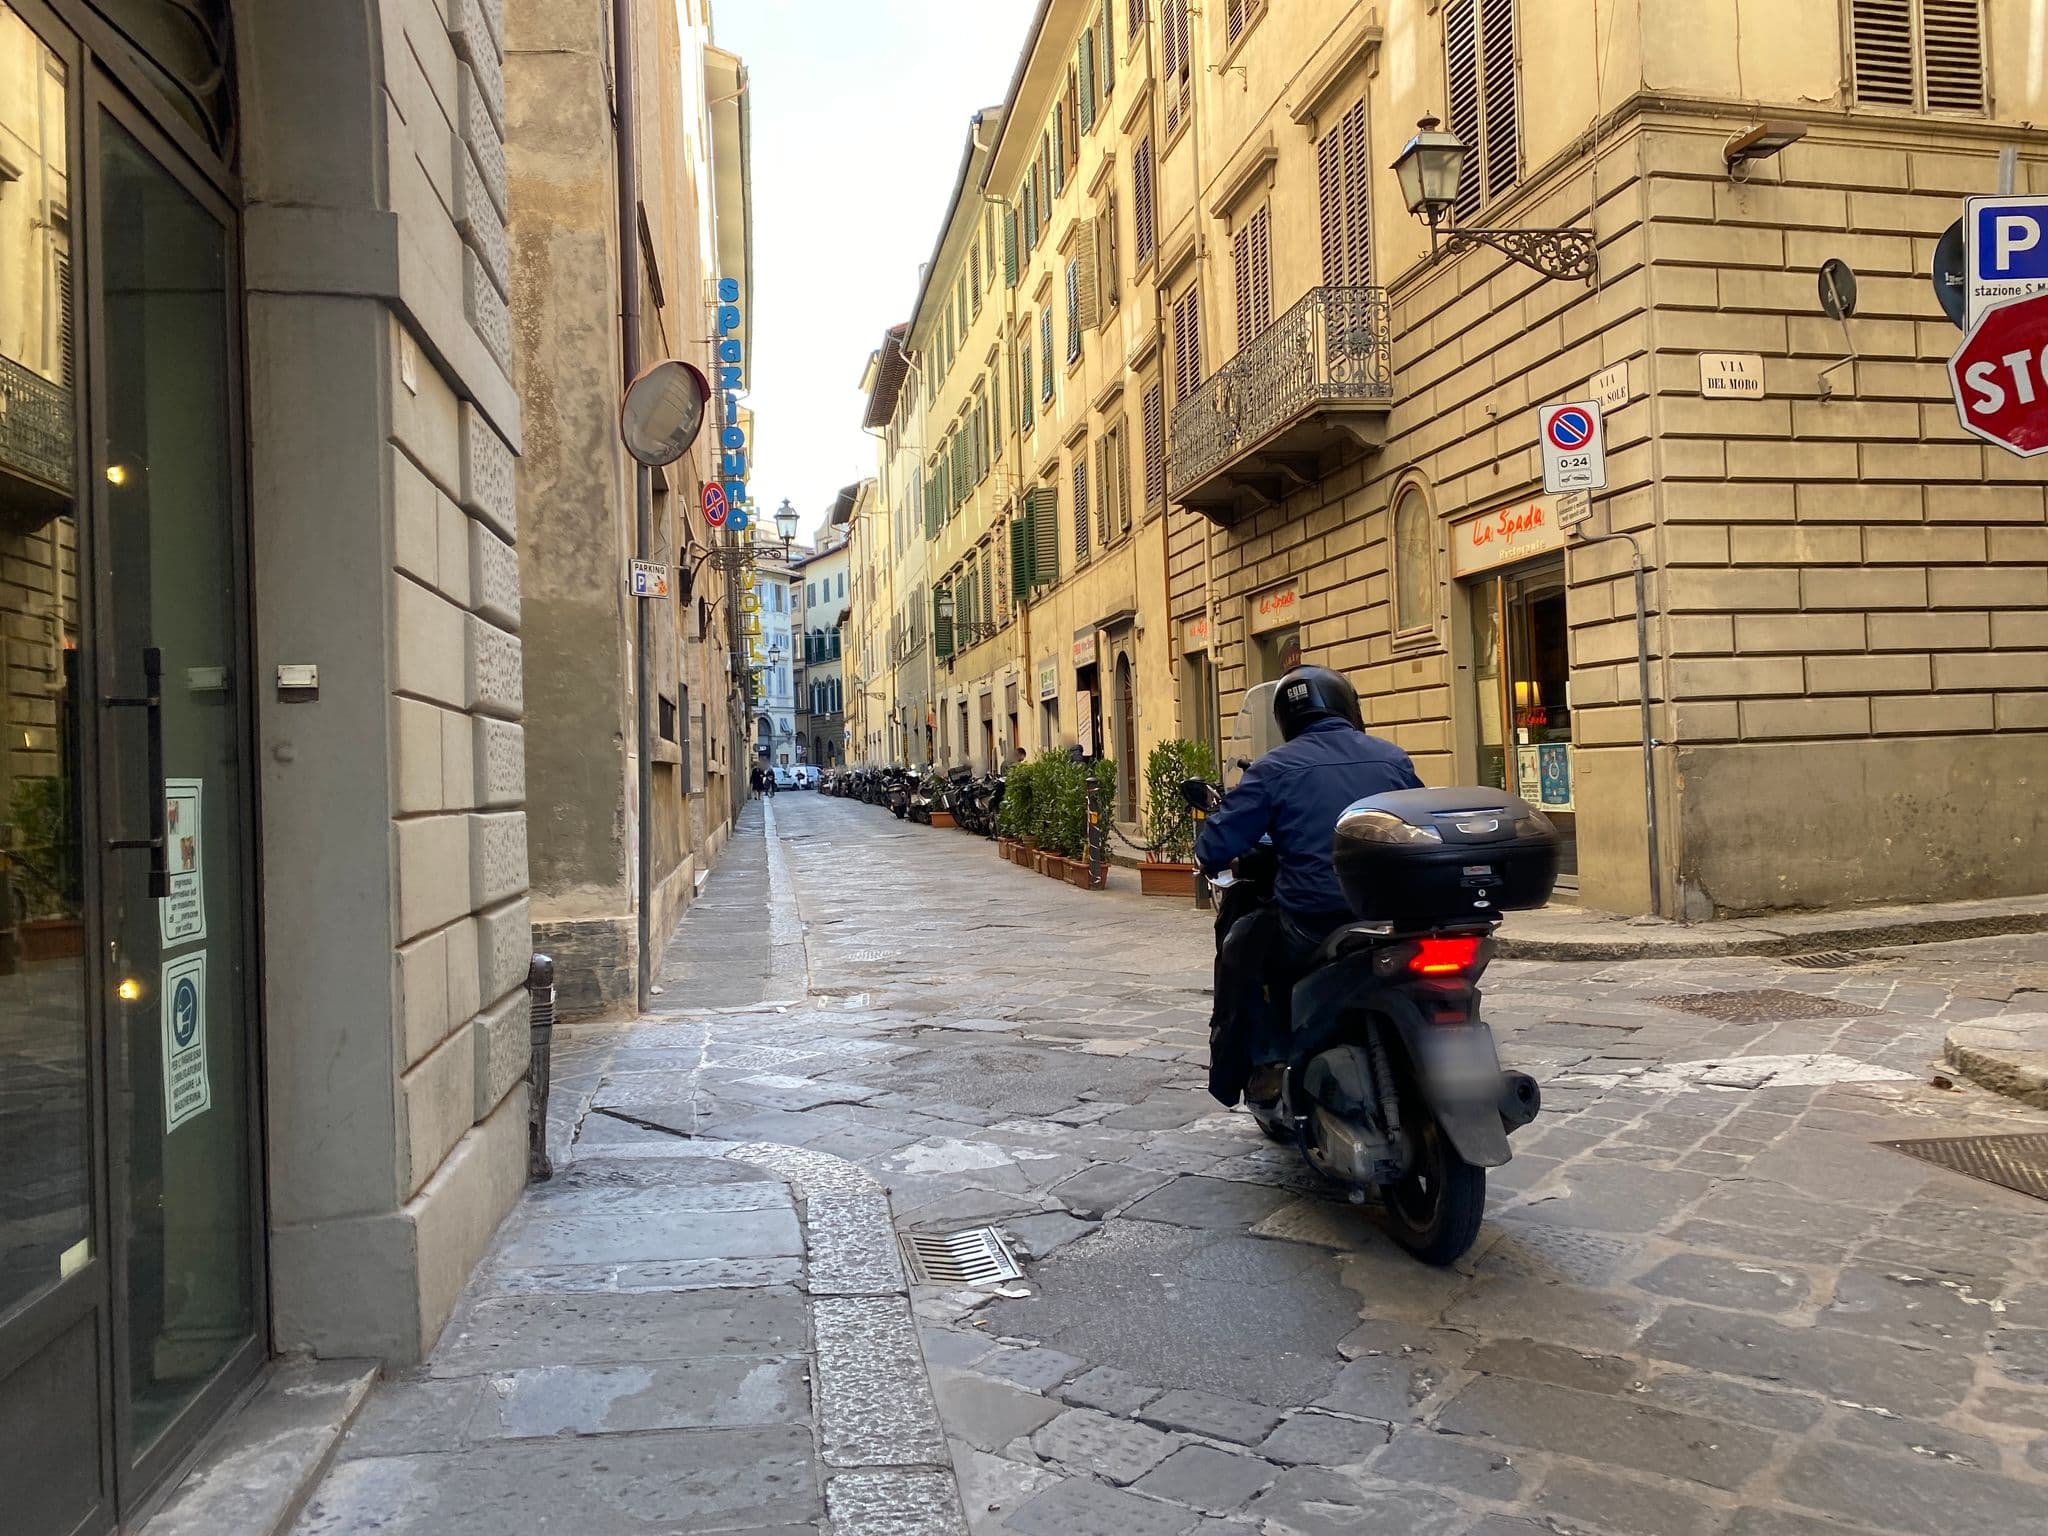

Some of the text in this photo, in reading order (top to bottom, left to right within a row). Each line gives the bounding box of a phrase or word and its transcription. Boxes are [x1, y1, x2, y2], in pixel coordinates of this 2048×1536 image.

[1995, 215, 2041, 271] P
[1975, 284, 2022, 297] stazione
[1720, 360, 1745, 373] VIA
[1600, 373, 1616, 390] VIA
[1708, 377, 1759, 392] DEL MORO
[1607, 385, 1627, 404] SOLE
[1560, 457, 1588, 469] 0-24
[1472, 520, 1492, 546] La
[1497, 504, 1544, 544] Spada
[634, 563, 665, 575] PARKING
